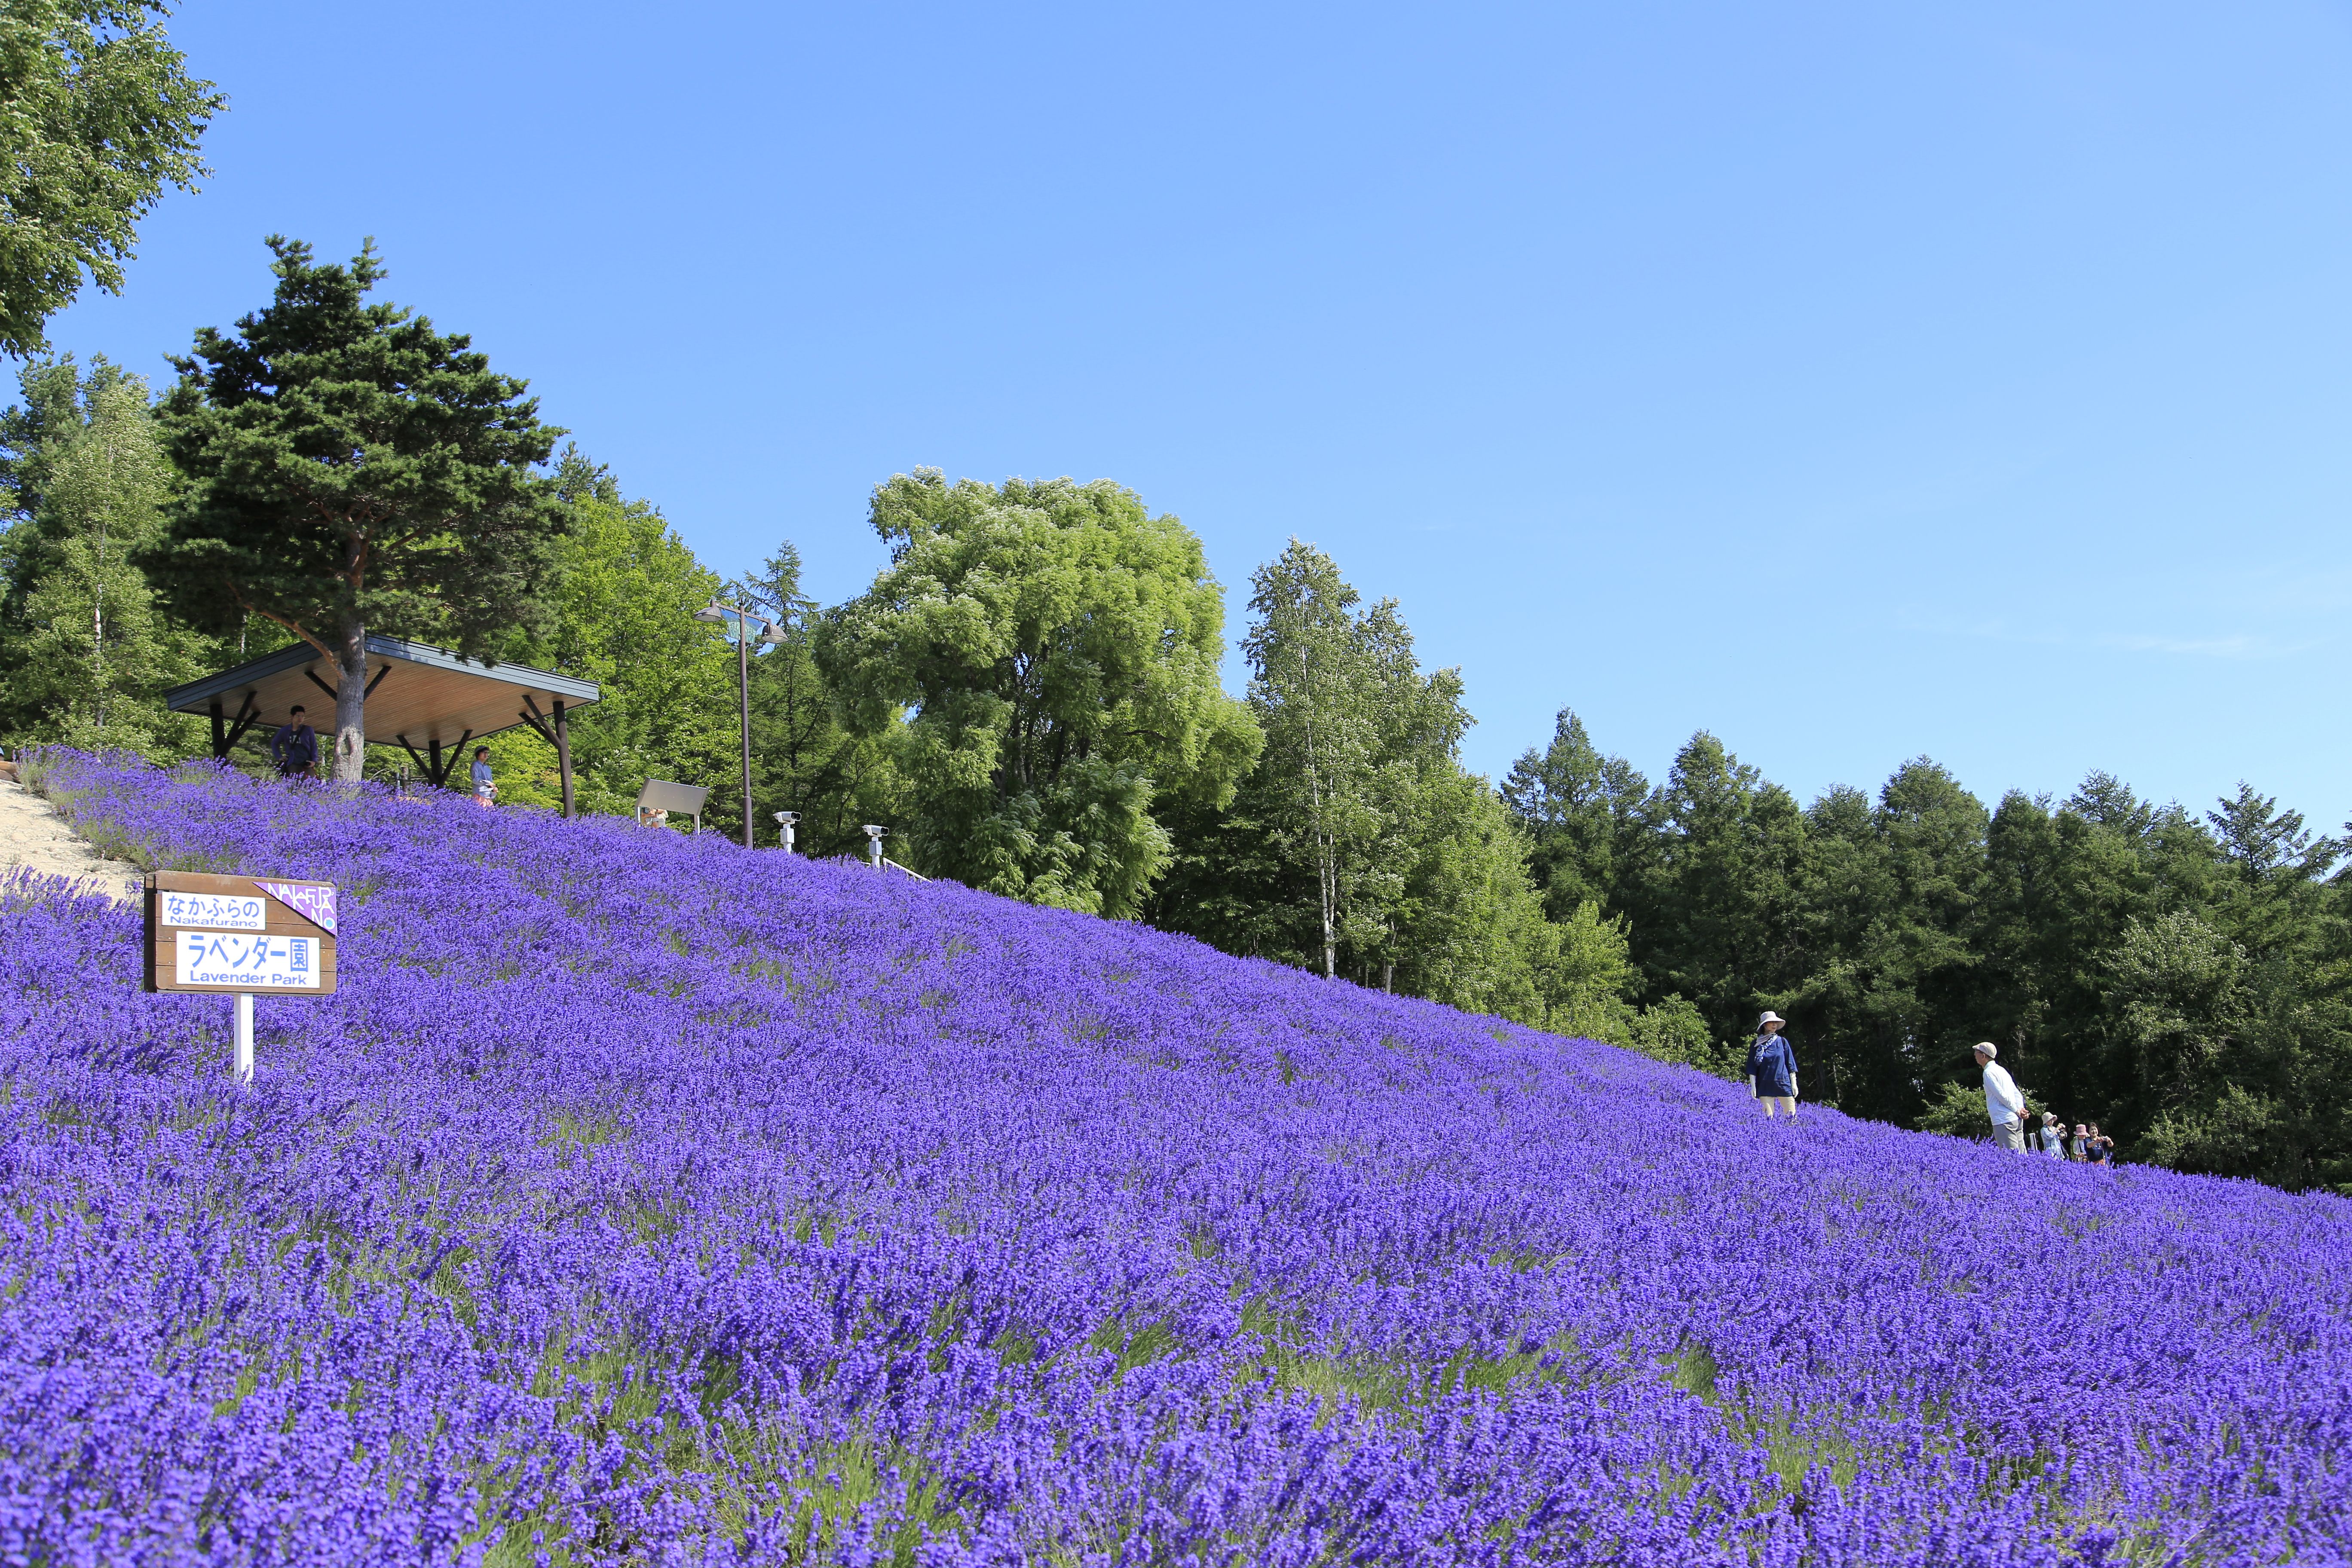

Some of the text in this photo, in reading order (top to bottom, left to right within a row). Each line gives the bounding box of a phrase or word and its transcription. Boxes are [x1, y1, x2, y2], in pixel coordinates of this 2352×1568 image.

[168, 895, 259, 918] なかふらの
[170, 916, 257, 928] Nakafurano
[188, 934, 309, 972] ラベンダー園
[190, 971, 307, 985] Lavender Park
